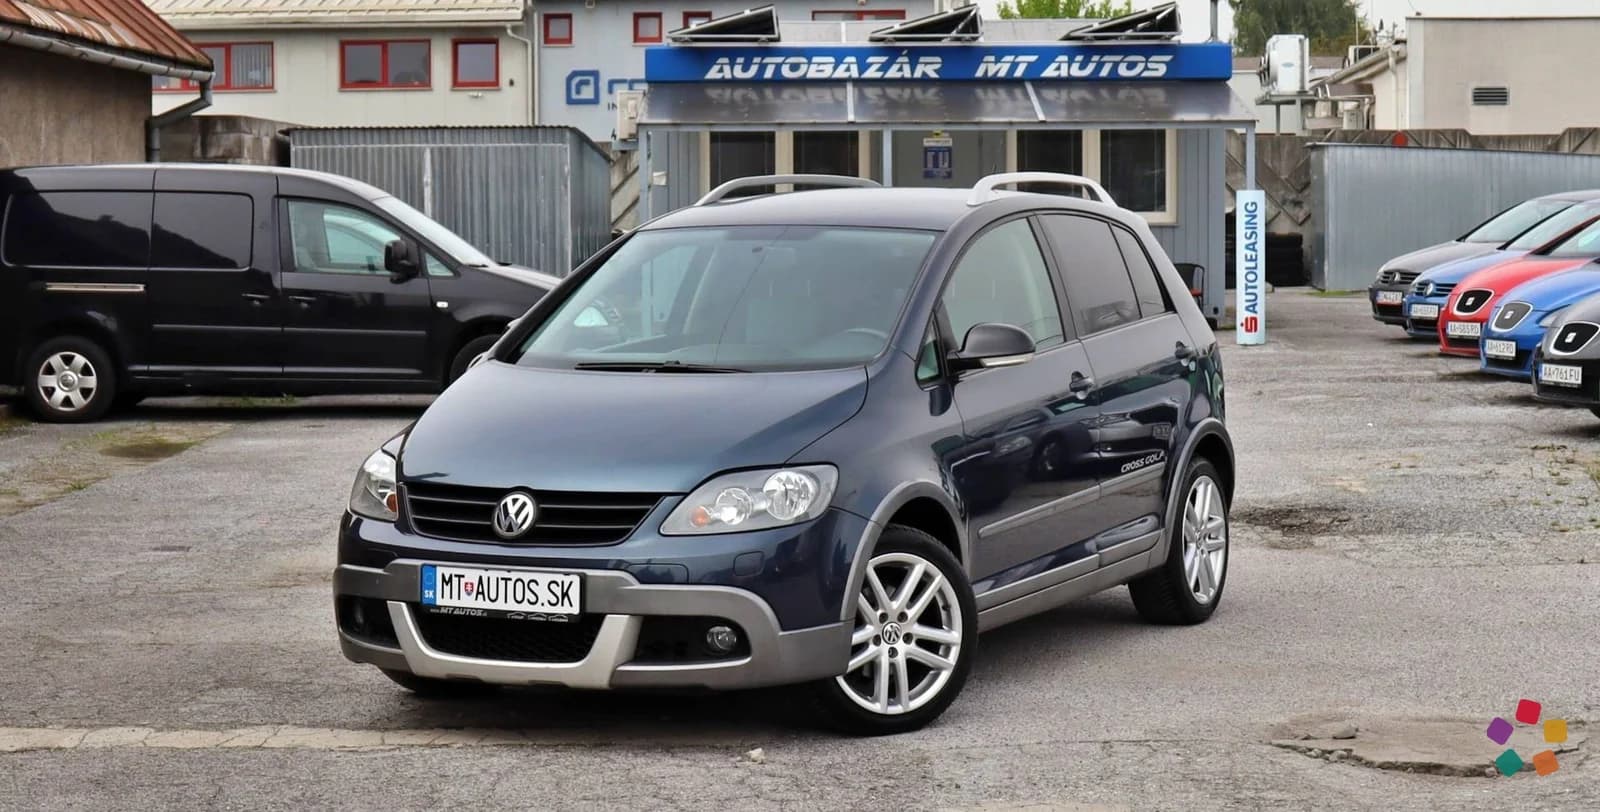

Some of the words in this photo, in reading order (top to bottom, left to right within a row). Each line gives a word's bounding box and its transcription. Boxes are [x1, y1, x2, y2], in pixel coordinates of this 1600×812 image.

[704, 50, 943, 79] AUTOBAZÁR
[974, 55, 1039, 78] MT
[1040, 55, 1174, 78] AUTOS
[1244, 201, 1258, 314] AUTOLEASING
[1121, 458, 1145, 473] CROSS
